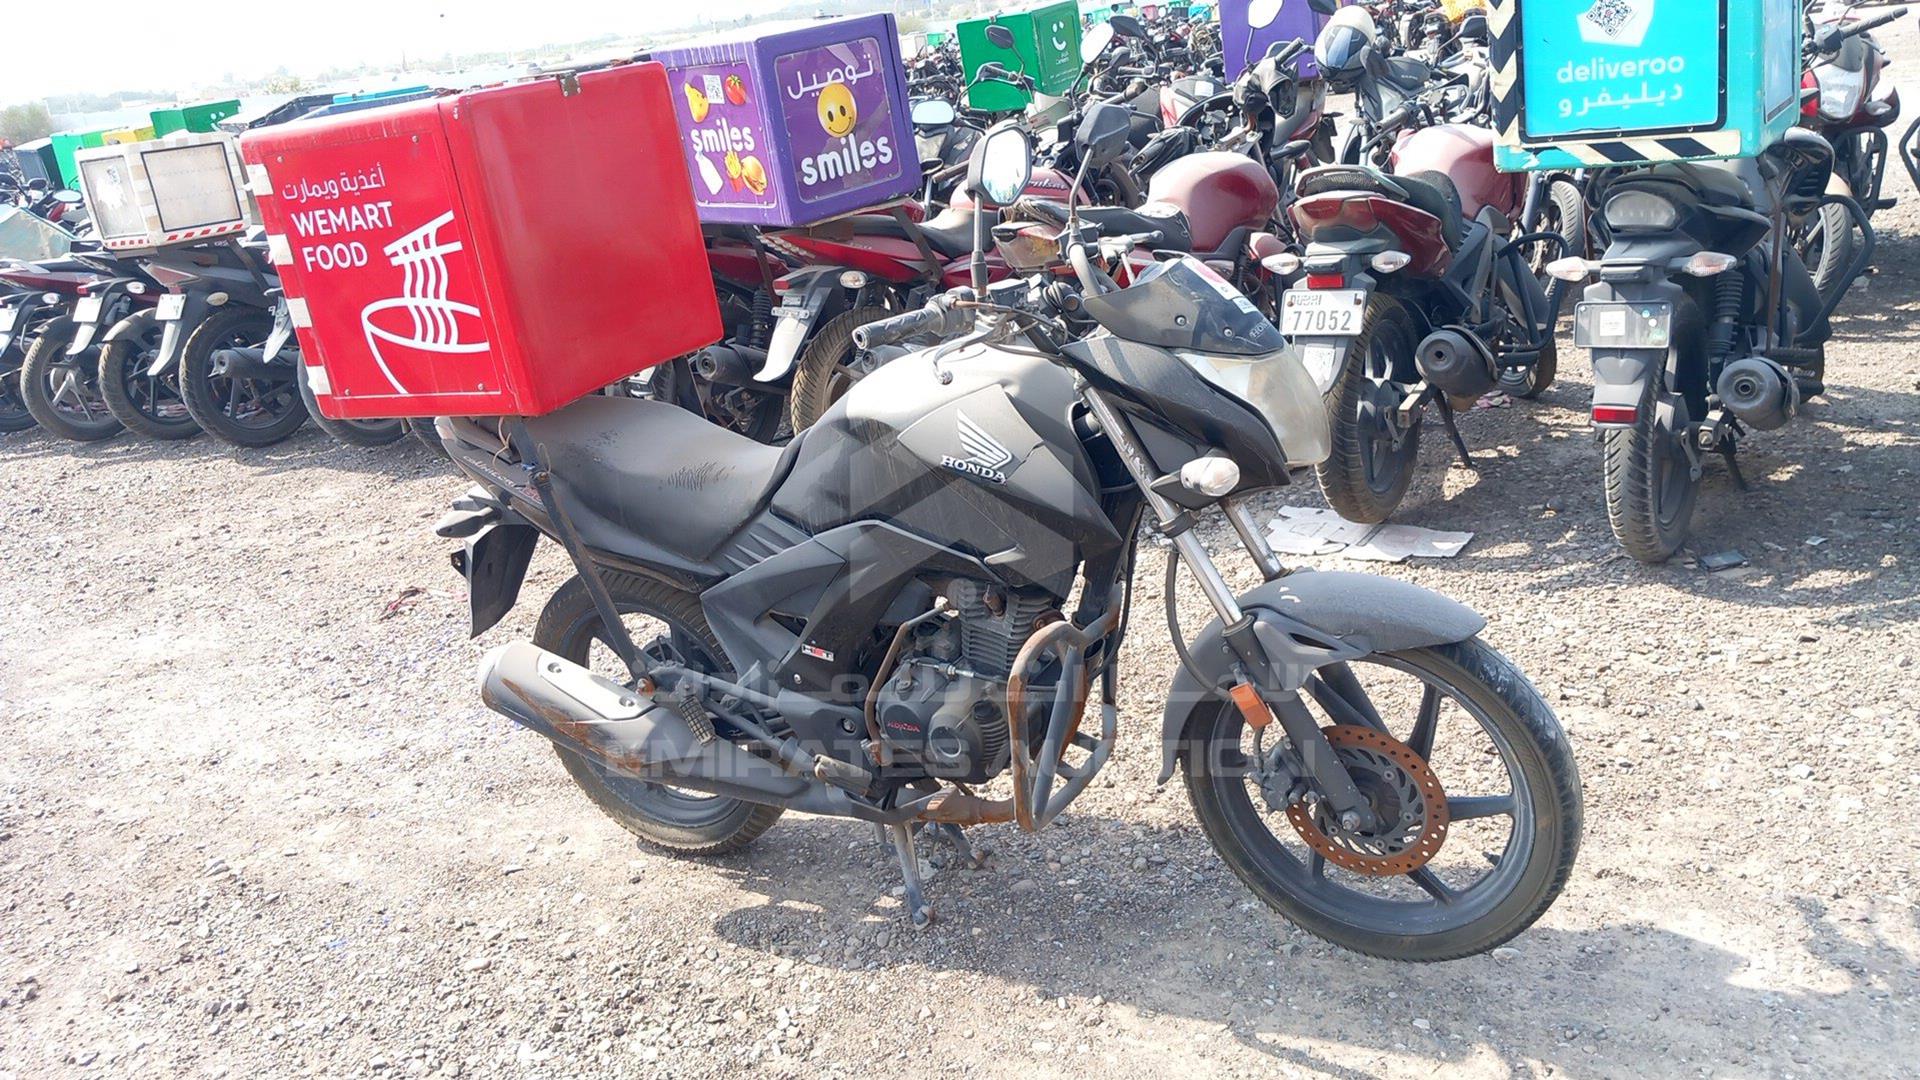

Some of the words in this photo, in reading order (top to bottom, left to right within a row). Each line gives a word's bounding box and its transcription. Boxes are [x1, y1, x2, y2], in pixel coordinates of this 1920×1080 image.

[787, 53, 874, 99] توصيل
[1556, 55, 1685, 84] deliveroo
[690, 117, 755, 152] smiles
[800, 132, 893, 186] smiles
[282, 177, 340, 204] ويمارت
[340, 162, 386, 196] أغذية
[290, 201, 393, 237] WEMART
[302, 242, 368, 273] FOOD
[1293, 310, 1352, 331] 77052
[940, 454, 1008, 487] HONDA
[887, 720, 920, 733] HONDA
